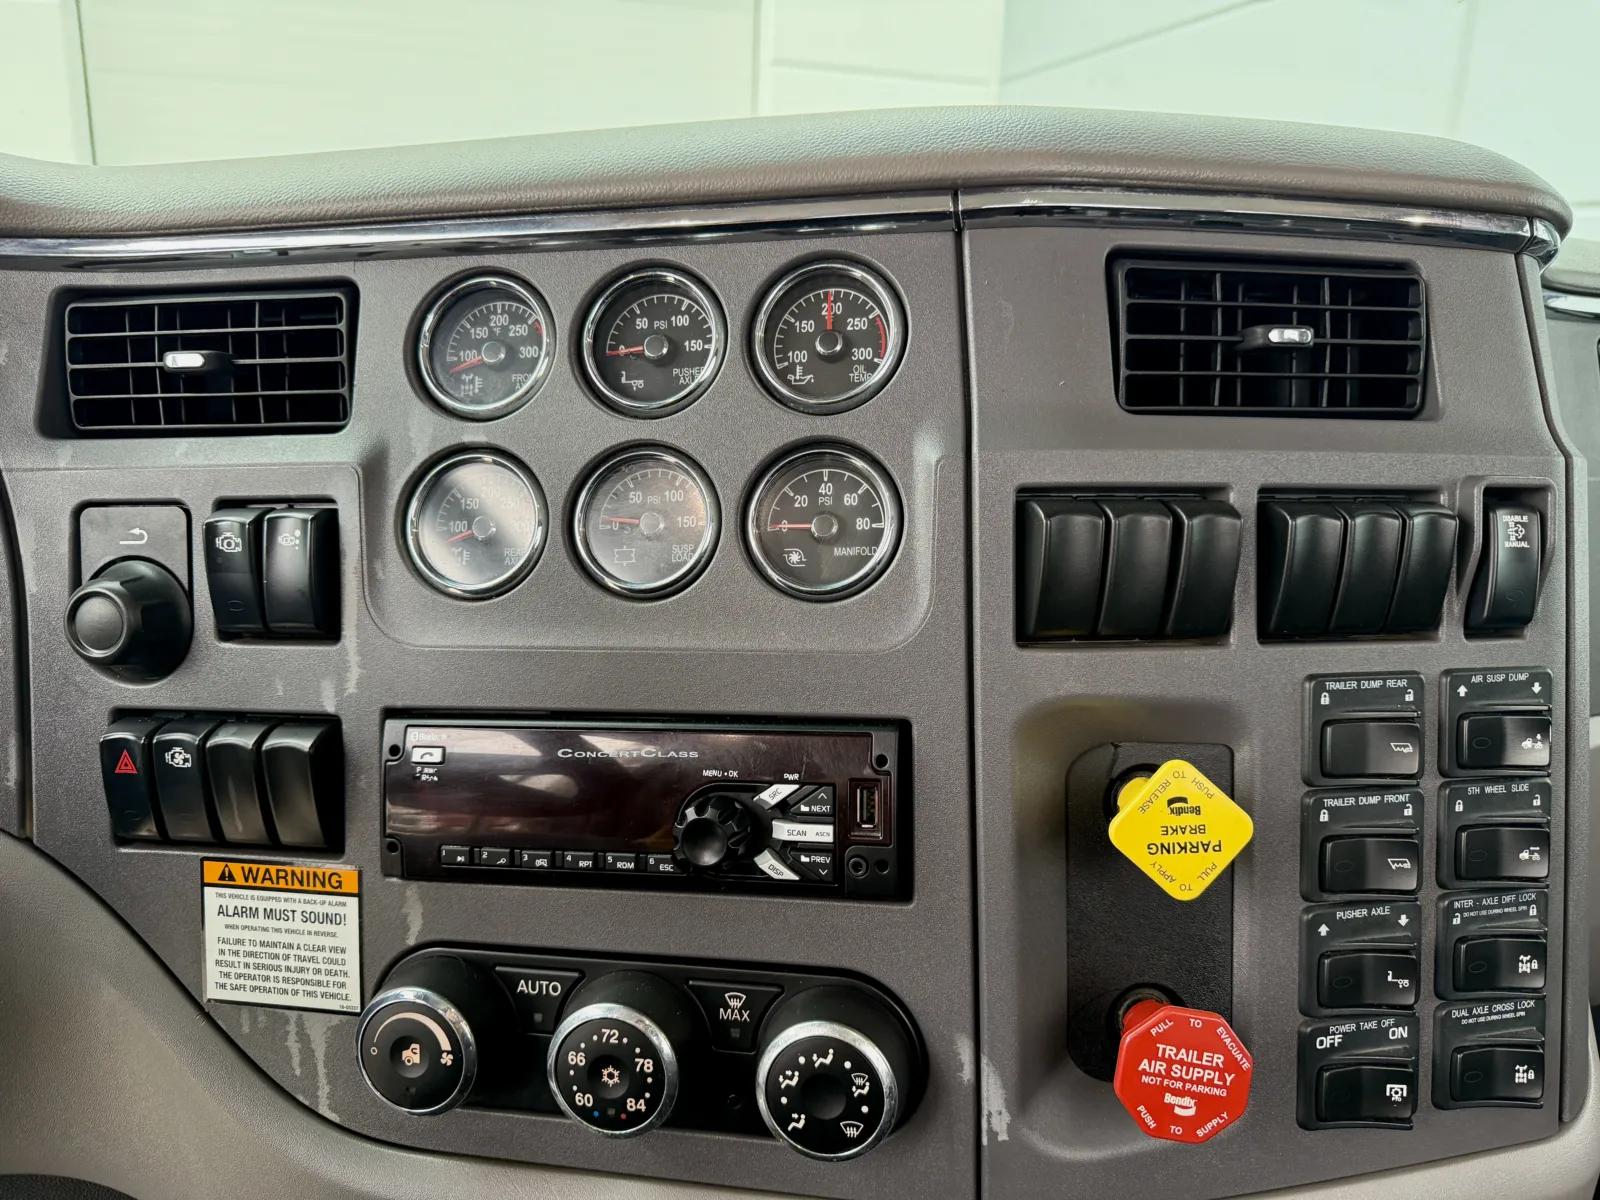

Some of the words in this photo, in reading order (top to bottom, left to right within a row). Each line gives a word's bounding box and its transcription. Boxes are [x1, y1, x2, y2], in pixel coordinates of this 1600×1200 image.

[821, 303, 842, 315] 200
[490, 315, 509, 326] 200
[635, 317, 648, 329] 50
[654, 321, 668, 329] PSI
[670, 315, 689, 326] 100
[795, 320, 815, 332] 150
[846, 318, 868, 330] 250
[470, 327, 489, 339] 150
[509, 325, 528, 336] 250
[684, 340, 703, 351] 150
[459, 350, 478, 361] 100
[520, 346, 539, 358] 300
[787, 351, 808, 362] 100
[851, 348, 873, 360] 300
[852, 365, 866, 374] OIL
[849, 374, 873, 382] TEMP
[818, 483, 833, 495] 40
[629, 492, 642, 504] 50
[647, 496, 661, 504] PSI
[664, 490, 684, 501] 100
[794, 495, 808, 507] 20
[818, 497, 833, 506] PSI
[844, 494, 858, 505] 60
[460, 498, 479, 510] 150
[449, 521, 468, 532] 100
[677, 516, 696, 527] 150
[781, 520, 788, 532] 0
[856, 518, 870, 530] 80
[672, 545, 694, 553] SUSP
[834, 547, 879, 556] MANIFOLD
[672, 553, 694, 562] LOAD
[1470, 675, 1483, 683] AIR
[1486, 674, 1506, 683] SUSP
[1508, 673, 1530, 682] DUMP
[1324, 681, 1358, 690] TRAILER
[1360, 680, 1383, 689] DUMP
[1386, 679, 1408, 688] REAR
[728, 770, 739, 778] OK
[1172, 771, 1187, 779] TO
[768, 788, 783, 800] SRC
[1191, 778, 1215, 799] PUSH
[1467, 787, 1480, 795] 5TH
[1484, 785, 1507, 794] WHEEL
[1511, 784, 1529, 793] SLIDE
[1137, 779, 1172, 814] RELEASE
[1323, 797, 1356, 807] TRAILER
[1358, 795, 1381, 805] DUMP
[1384, 794, 1411, 803] FRONT
[1170, 805, 1201, 816] Bendix
[1160, 824, 1206, 835] BRAKE
[1147, 840, 1222, 855] PARKING
[767, 864, 784, 876] DISP
[1150, 861, 1176, 883] APPLY
[1197, 863, 1218, 880] PULL
[240, 865, 343, 890] WARNING
[228, 893, 249, 901] VEHICLE
[256, 895, 282, 903] EQUIPPED
[1454, 899, 1474, 909] INTER
[1481, 897, 1499, 906] AXLE
[1501, 895, 1516, 904] DIFF
[1519, 893, 1537, 902] LOCK
[217, 904, 260, 920] ALARM
[263, 907, 297, 923] MUST
[301, 910, 347, 927] SOUND!
[1336, 909, 1368, 920] PUSHER
[1370, 906, 1391, 916] AXLE
[240, 925, 271, 933] OPERATING
[270, 926, 283, 934] THIS
[283, 927, 306, 936] VEHICLE
[217, 937, 246, 946] FAILURE
[248, 939, 258, 947] TO
[259, 940, 295, 950] MAINTAIN
[295, 942, 302, 950] A
[303, 943, 327, 953] CLEAR
[328, 945, 347, 955] VIEW
[227, 949, 241, 957] THE
[242, 950, 280, 961] DIRECTION
[281, 953, 292, 961] OF
[293, 954, 321, 964] TRAVEL
[322, 956, 346, 966] COULD
[215, 959, 241, 969] RESULT
[243, 961, 251, 969] IN
[252, 962, 283, 972] SERIOUS
[284, 965, 310, 975] INJURY
[312, 967, 323, 975] OR
[324, 969, 350, 979] DEATH.
[218, 971, 233, 979] THE
[234, 972, 271, 983] OPERATOR
[273, 975, 280, 983] IS
[282, 976, 331, 988] RESPONSIBLE
[332, 980, 347, 989] FOR
[215, 982, 228, 990] THE
[229, 983, 248, 992] SAFE
[249, 985, 289, 996] OPERATION
[290, 988, 300, 996] OF
[301, 989, 319, 998] THIS
[320, 990, 352, 1001] VEHICLE.
[516, 979, 562, 995] AUTO
[719, 1008, 750, 1022] MAX
[1451, 1008, 1469, 1018] DUAL
[1471, 1005, 1489, 1016] AXLE
[1491, 1002, 1515, 1013] CROSS
[1517, 1000, 1536, 1009] LOCK
[1329, 1023, 1357, 1034] POWER
[1360, 1021, 1378, 1030] TAKE
[1380, 1018, 1396, 1028] OFF
[601, 1029, 619, 1044] 72
[1388, 1026, 1408, 1040] ON
[1150, 1019, 1174, 1036] PULL
[1189, 1018, 1203, 1028] TO
[1216, 1026, 1251, 1071] EVACUATE
[1316, 1034, 1343, 1049] OFF
[567, 1051, 586, 1066] 66
[1156, 1044, 1224, 1068] TRAILER
[634, 1058, 654, 1072] 78
[1137, 1059, 1167, 1075] AIR
[1170, 1064, 1236, 1086] SUPPLY
[1141, 1075, 1162, 1085] NOT
[1163, 1079, 1184, 1089] FOR
[1185, 1082, 1227, 1097] PARKING
[575, 1093, 594, 1107] 60
[626, 1098, 646, 1112] 84
[1163, 1093, 1196, 1107] Bendix
[1136, 1105, 1157, 1129] PUSH
[1170, 1125, 1183, 1135] TO
[1196, 1112, 1229, 1137] SUPPLY
